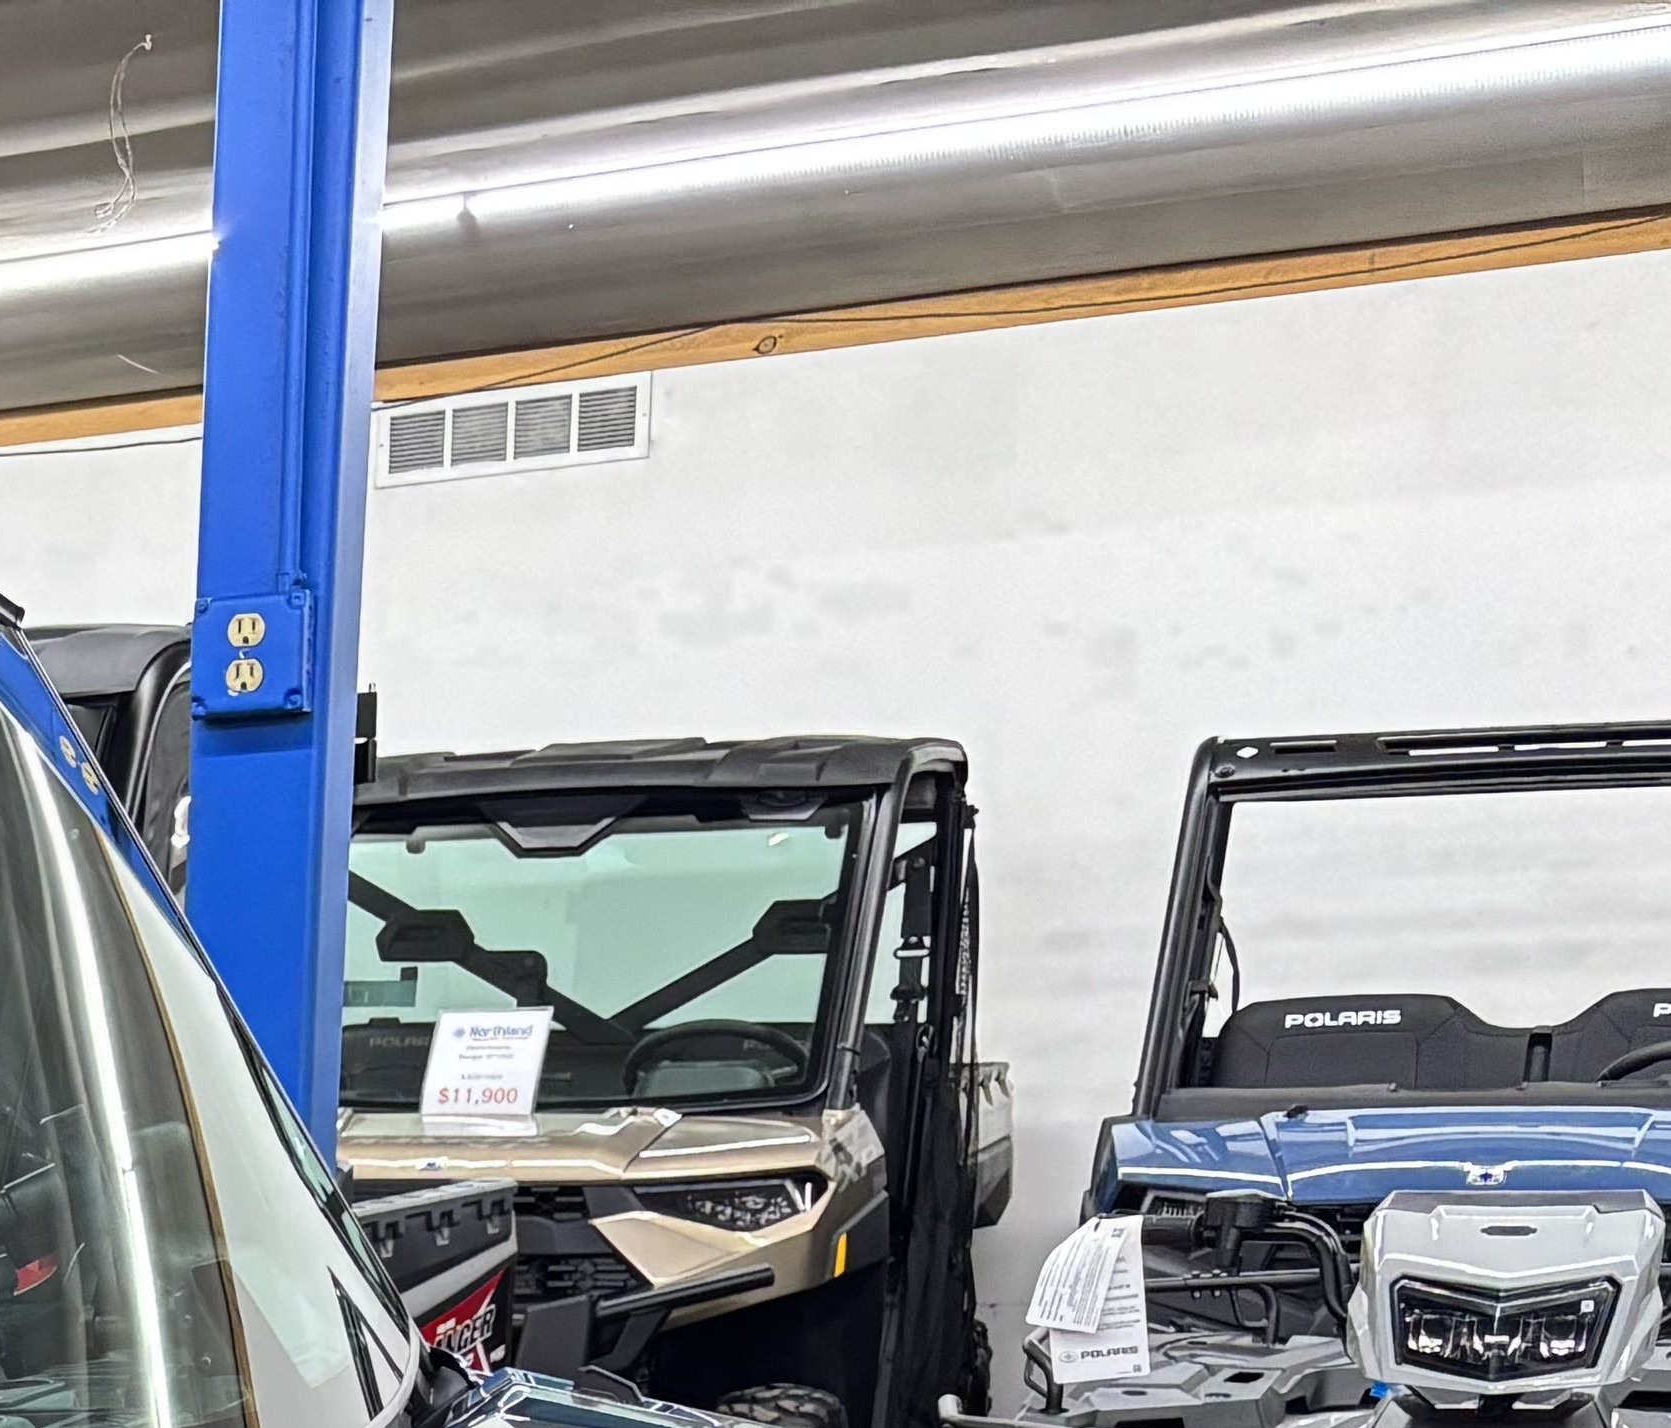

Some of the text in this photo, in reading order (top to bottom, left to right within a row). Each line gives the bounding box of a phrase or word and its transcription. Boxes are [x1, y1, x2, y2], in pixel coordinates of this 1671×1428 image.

[1284, 1009, 1402, 1029] POLARIS
[437, 1087, 519, 1104] $11,900
[1080, 1345, 1139, 1361] POLARIS
